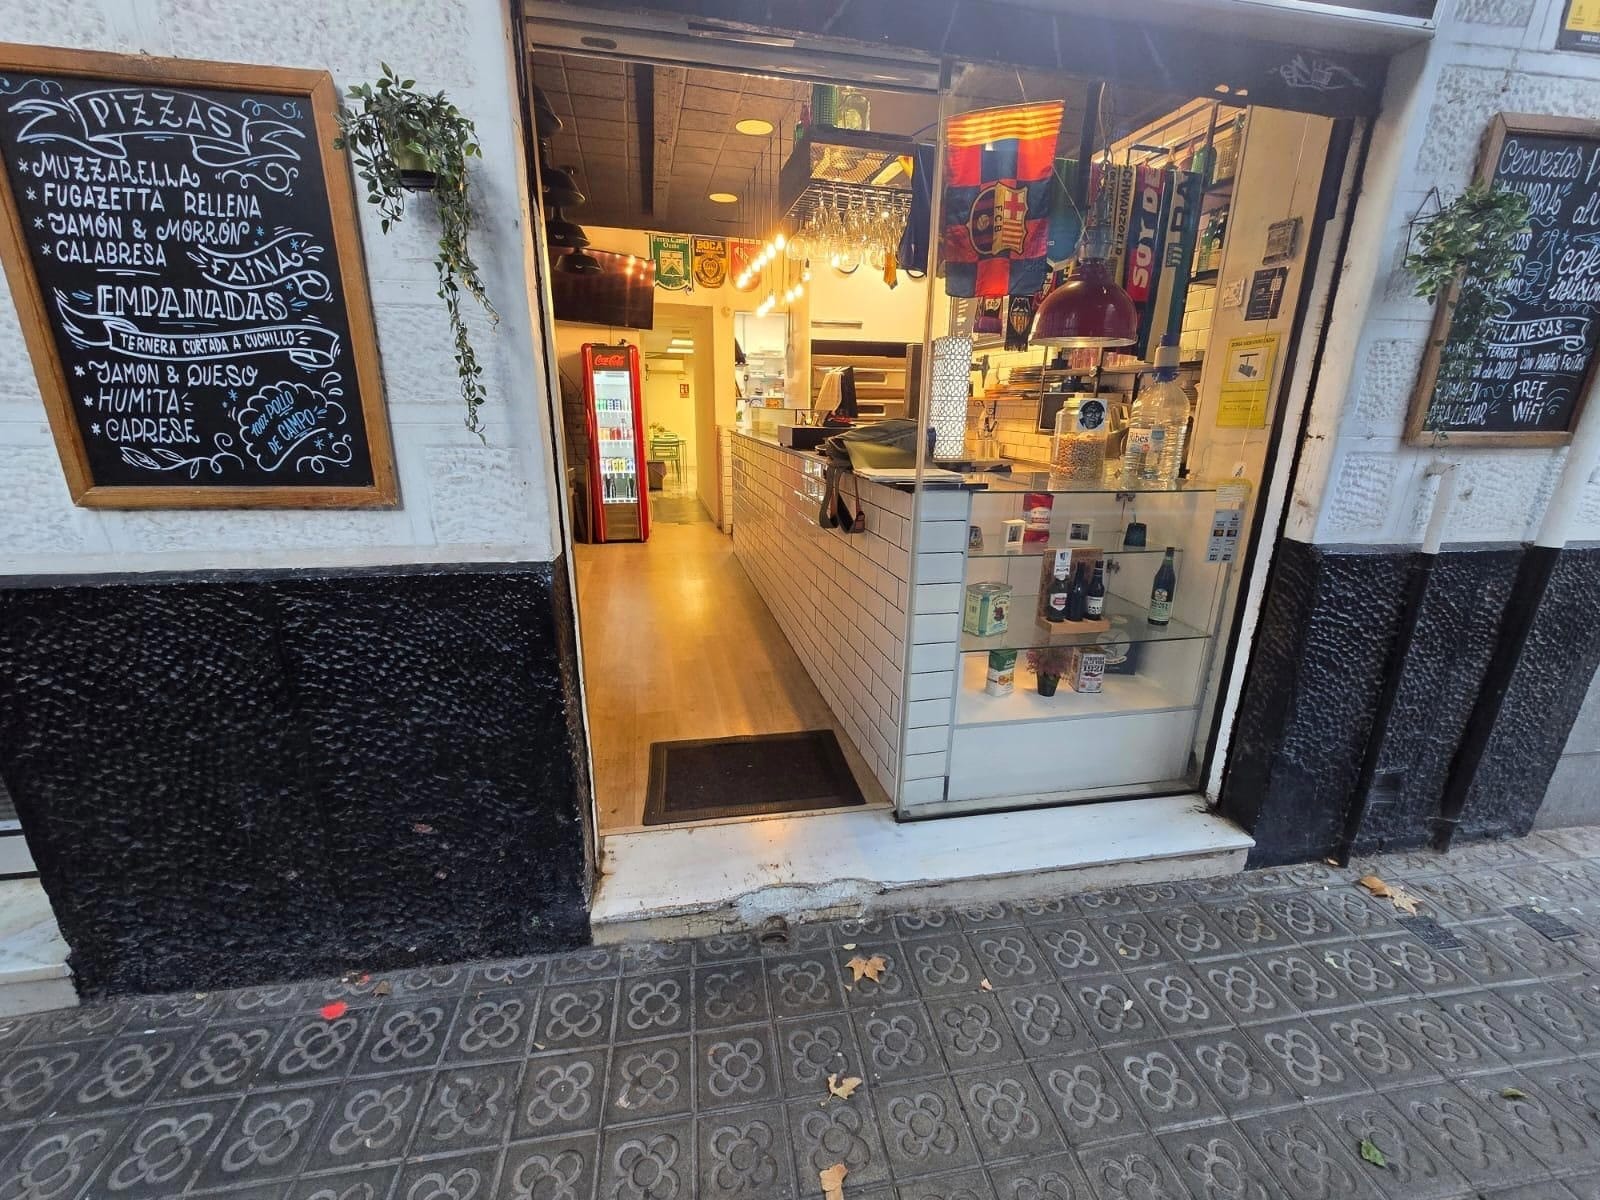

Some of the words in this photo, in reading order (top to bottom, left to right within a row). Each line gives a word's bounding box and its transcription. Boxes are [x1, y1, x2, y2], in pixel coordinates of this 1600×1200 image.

[33, 151, 200, 188] MUZZARELLA
[1499, 140, 1583, 178] Cervezas
[44, 183, 165, 213] FUGAZETTA
[184, 191, 262, 219] RELLENA
[48, 212, 122, 239] JAMÓN
[133, 219, 147, 239] &
[157, 217, 250, 246] MORRÓN
[57, 240, 167, 267] CALABRESA
[696, 240, 723, 250] BOCA
[97, 285, 289, 321] EMPANADAS
[119, 333, 177, 355] TERNERA
[183, 337, 230, 355] CORTADA
[233, 336, 242, 350] A
[244, 329, 295, 349] CUCHILLO
[1487, 346, 1518, 359] TERNERA
[89, 360, 159, 385] JAMON
[167, 364, 180, 385] &
[187, 363, 259, 388] QUESO
[1513, 380, 1548, 400] FREE
[251, 413, 270, 437] 100%
[264, 390, 295, 420] POLLO
[106, 418, 201, 444] CAPRESE
[267, 434, 283, 456] DE
[277, 408, 316, 441] CAMPO
